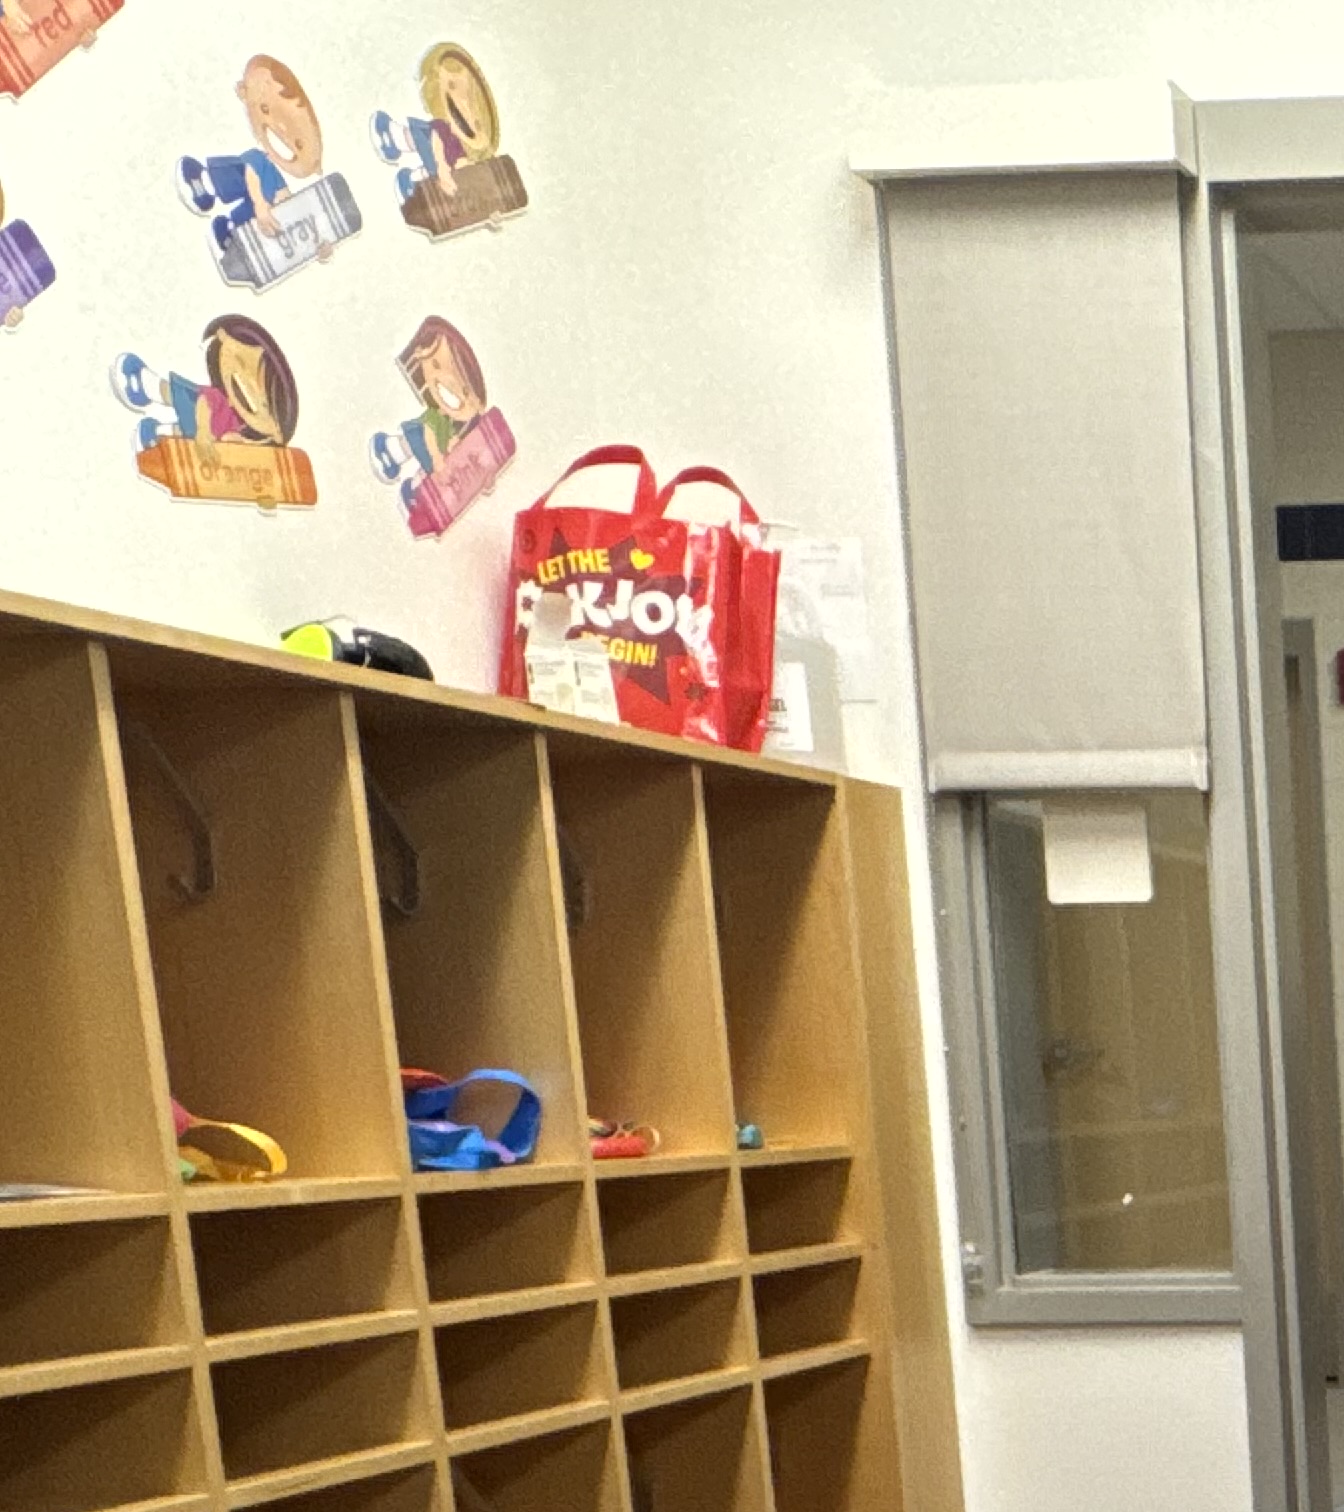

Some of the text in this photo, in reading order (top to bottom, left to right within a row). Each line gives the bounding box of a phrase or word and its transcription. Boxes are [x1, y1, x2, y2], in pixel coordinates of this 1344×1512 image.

[277, 214, 320, 259] gray
[200, 461, 274, 492] orange
[537, 548, 612, 584] LET THE
